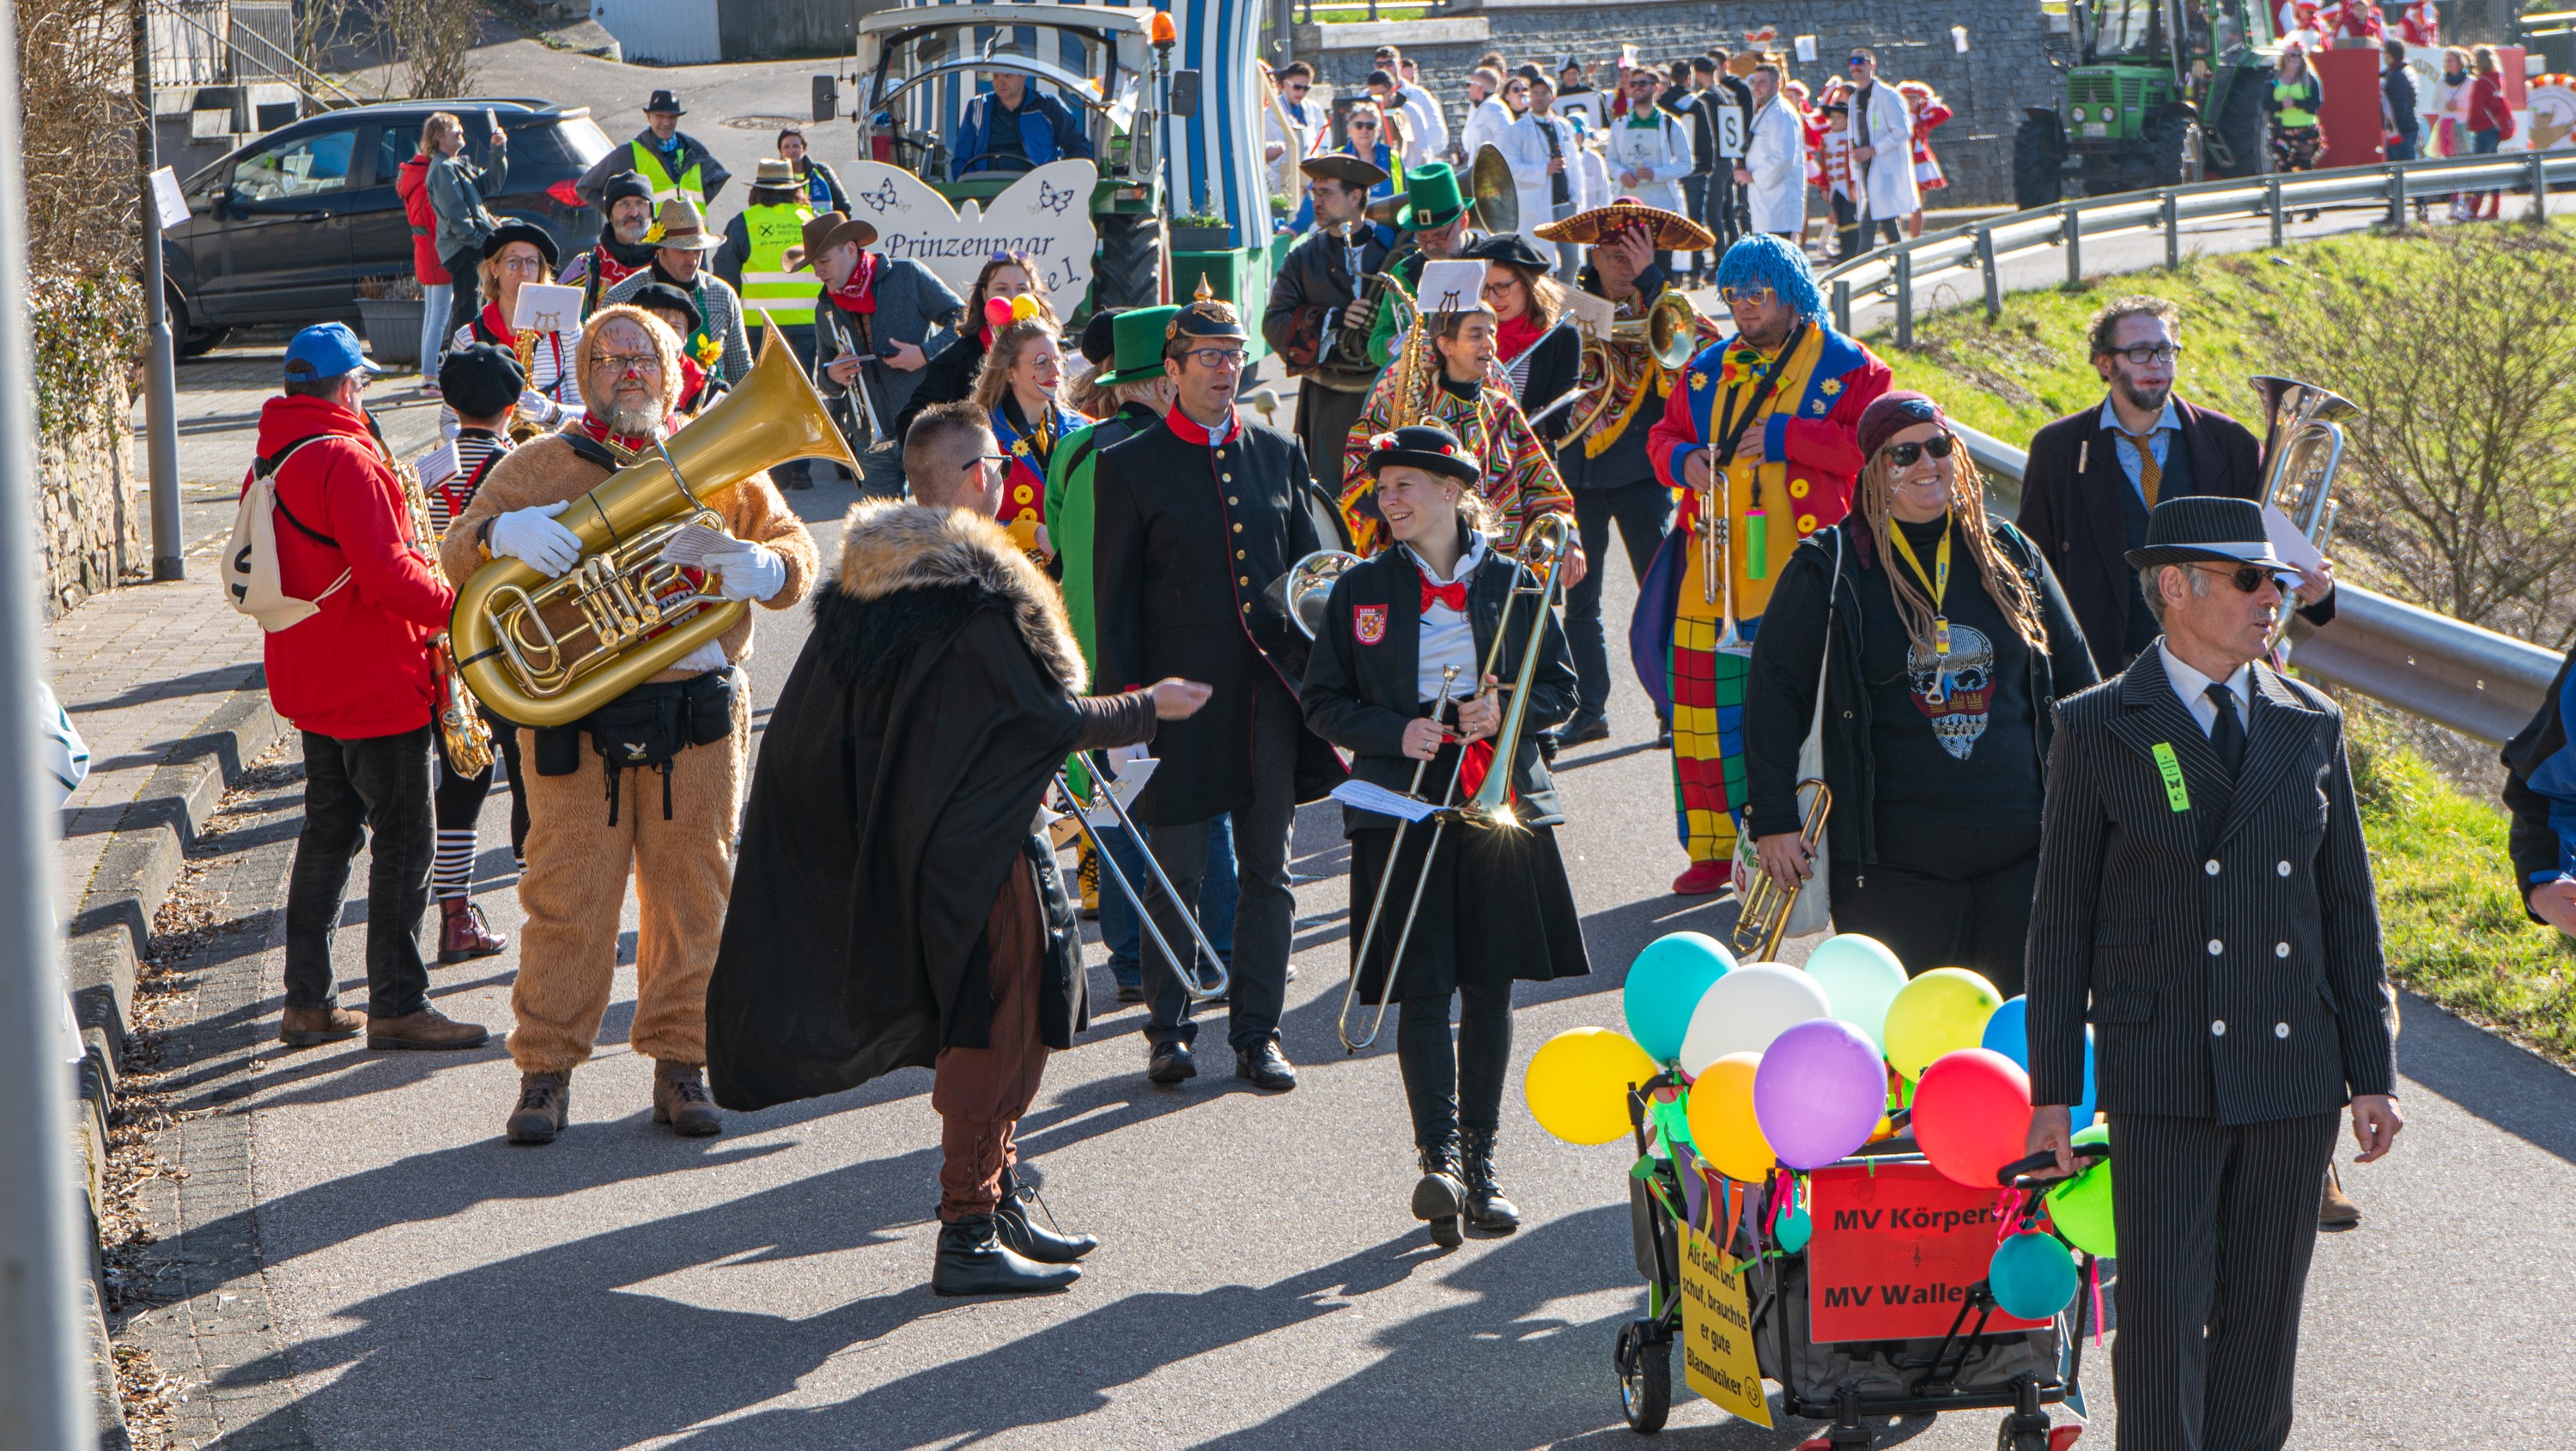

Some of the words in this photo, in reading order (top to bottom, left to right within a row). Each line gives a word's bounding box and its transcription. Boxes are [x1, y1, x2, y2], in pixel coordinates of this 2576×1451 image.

[1726, 116, 1736, 148] S
[1833, 1208, 1883, 1230] MV
[1687, 1245, 1701, 1267] Als
[1702, 1254, 1720, 1279] Gott
[1720, 1268, 1736, 1291] uns
[1682, 1276, 1706, 1308] schuf,
[1707, 1289, 1747, 1331] brauchte
[1824, 1285, 1874, 1308] MV
[1880, 1283, 1971, 1305] Walle
[1700, 1323, 1710, 1341] er
[1711, 1330, 1731, 1356] gute
[1686, 1345, 1742, 1397] Blasmusiker
